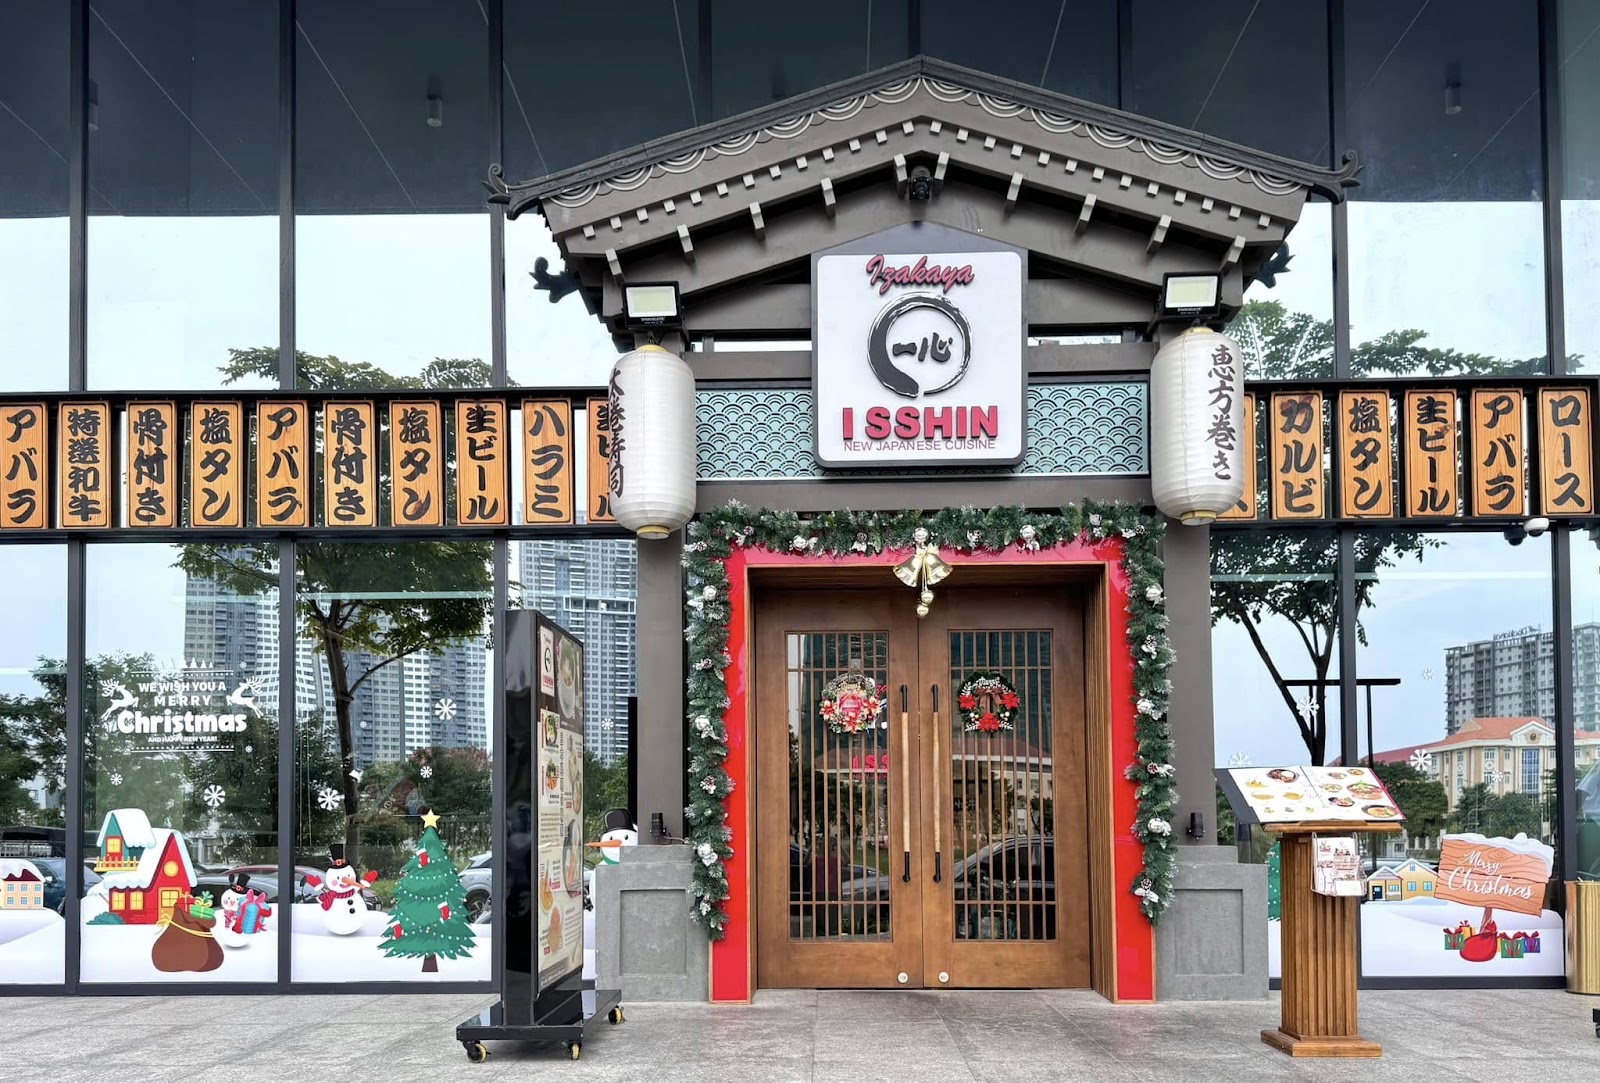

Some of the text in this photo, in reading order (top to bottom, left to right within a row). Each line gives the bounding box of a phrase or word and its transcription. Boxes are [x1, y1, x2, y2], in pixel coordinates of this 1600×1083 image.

[866, 254, 975, 295] Izakaya
[892, 332, 953, 363] 一心
[5, 408, 38, 524] アバラ
[67, 408, 101, 522] 特選和牛
[133, 408, 168, 522] 骨付き
[199, 408, 232, 522] 塩タン
[266, 407, 301, 522] アバラ
[331, 407, 367, 521] 骨付き
[399, 407, 432, 521] 塩タン
[466, 404, 498, 521] 生ビール
[528, 405, 566, 519] ハラミ
[843, 405, 998, 440] ISSHIN
[844, 439, 996, 451] NEW JAPANESE CUISINE
[1204, 344, 1236, 481] 恵方巻き
[1279, 399, 1316, 514] カルビ
[1348, 397, 1382, 511] 塩タン
[1416, 395, 1449, 513] 生ビール
[1483, 395, 1516, 511] アバラ
[1549, 394, 1585, 508] ロース
[118, 708, 248, 734] Christmas
[138, 681, 226, 693] WE WISH YOU A
[154, 695, 211, 707] MERRY
[1447, 866, 1536, 899] Christmas
